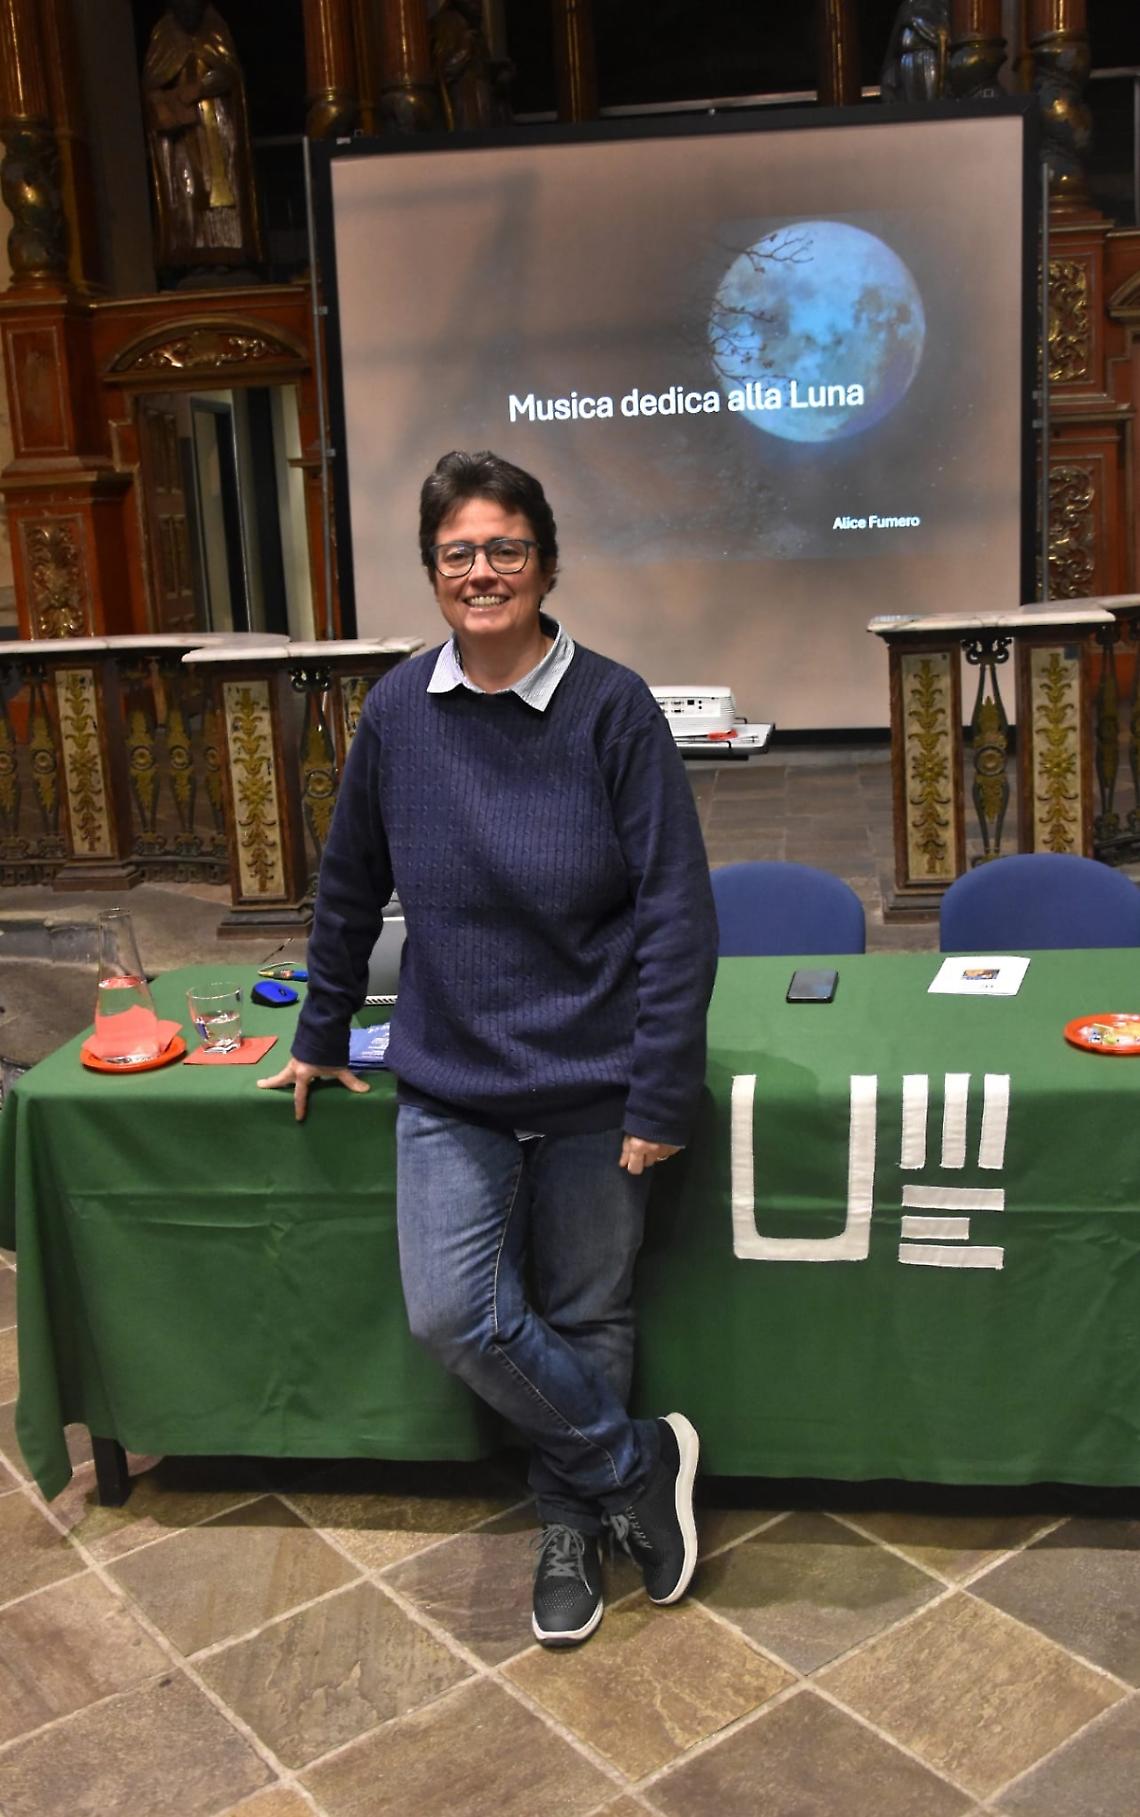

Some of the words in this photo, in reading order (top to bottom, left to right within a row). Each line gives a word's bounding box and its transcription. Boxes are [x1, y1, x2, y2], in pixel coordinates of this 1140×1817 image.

[508, 391, 614, 422] Musica
[620, 386, 720, 417] dedica
[727, 382, 782, 412] alla
[790, 380, 865, 408] Luna
[832, 516, 867, 530] Alice
[868, 515, 921, 529] Fumero
